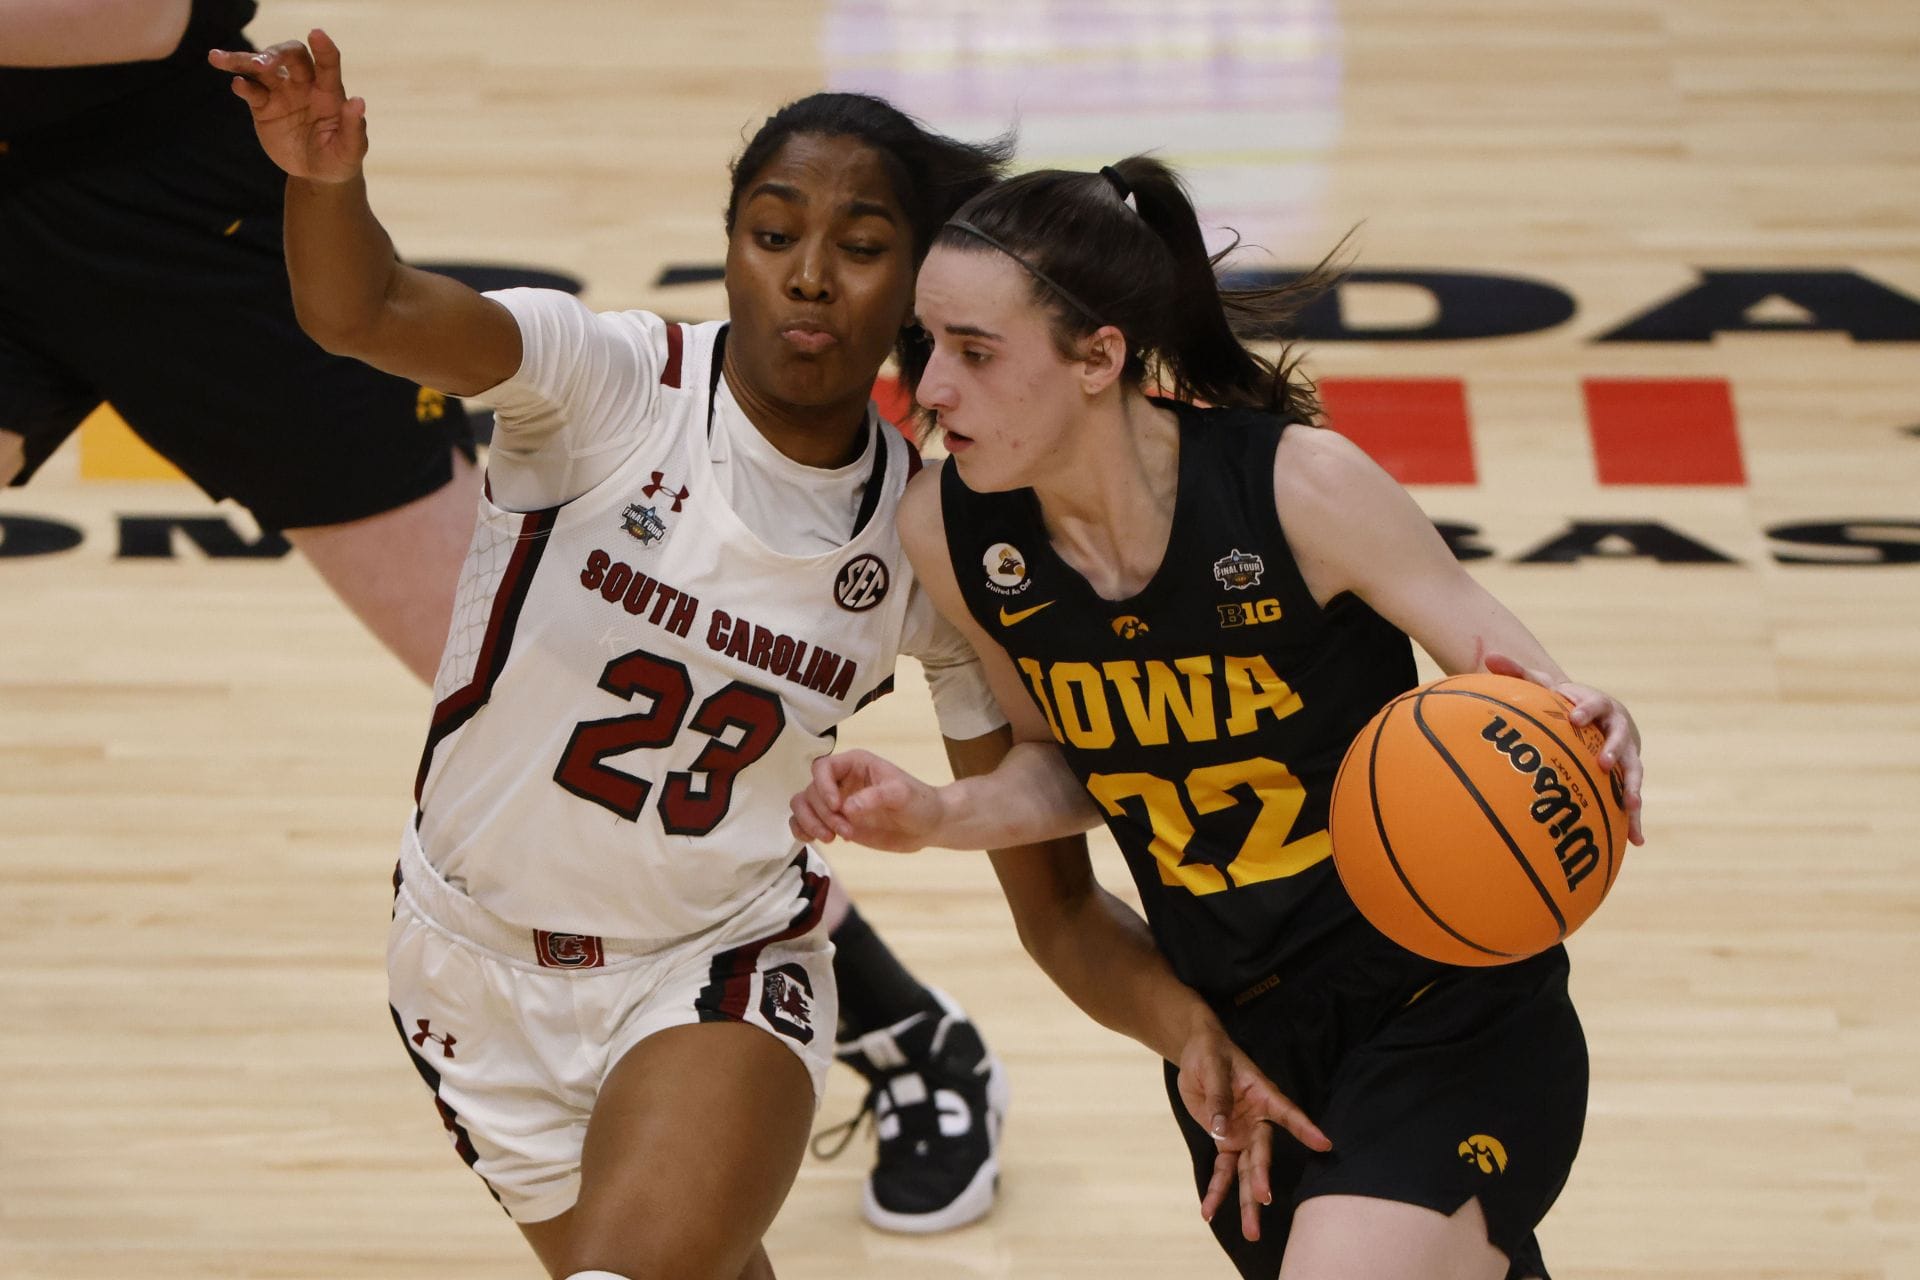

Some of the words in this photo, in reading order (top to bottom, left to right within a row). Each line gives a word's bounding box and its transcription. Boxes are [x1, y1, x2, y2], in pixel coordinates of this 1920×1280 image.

[623, 508, 645, 525] FINAL
[643, 520, 663, 539] FOUR
[838, 558, 885, 608] SEC
[985, 581, 1010, 595] United
[1217, 565, 1239, 578] FINAL
[1240, 563, 1261, 573] FOUR
[580, 549, 699, 638] SOUTH
[706, 609, 857, 701] CAROLINA
[1018, 654, 1304, 749] IOWA
[553, 649, 786, 836] 23
[1551, 757, 1571, 781] NXT
[1481, 715, 1600, 893] Wilson
[1571, 782, 1588, 808] EVO
[1086, 756, 1333, 896] 22
